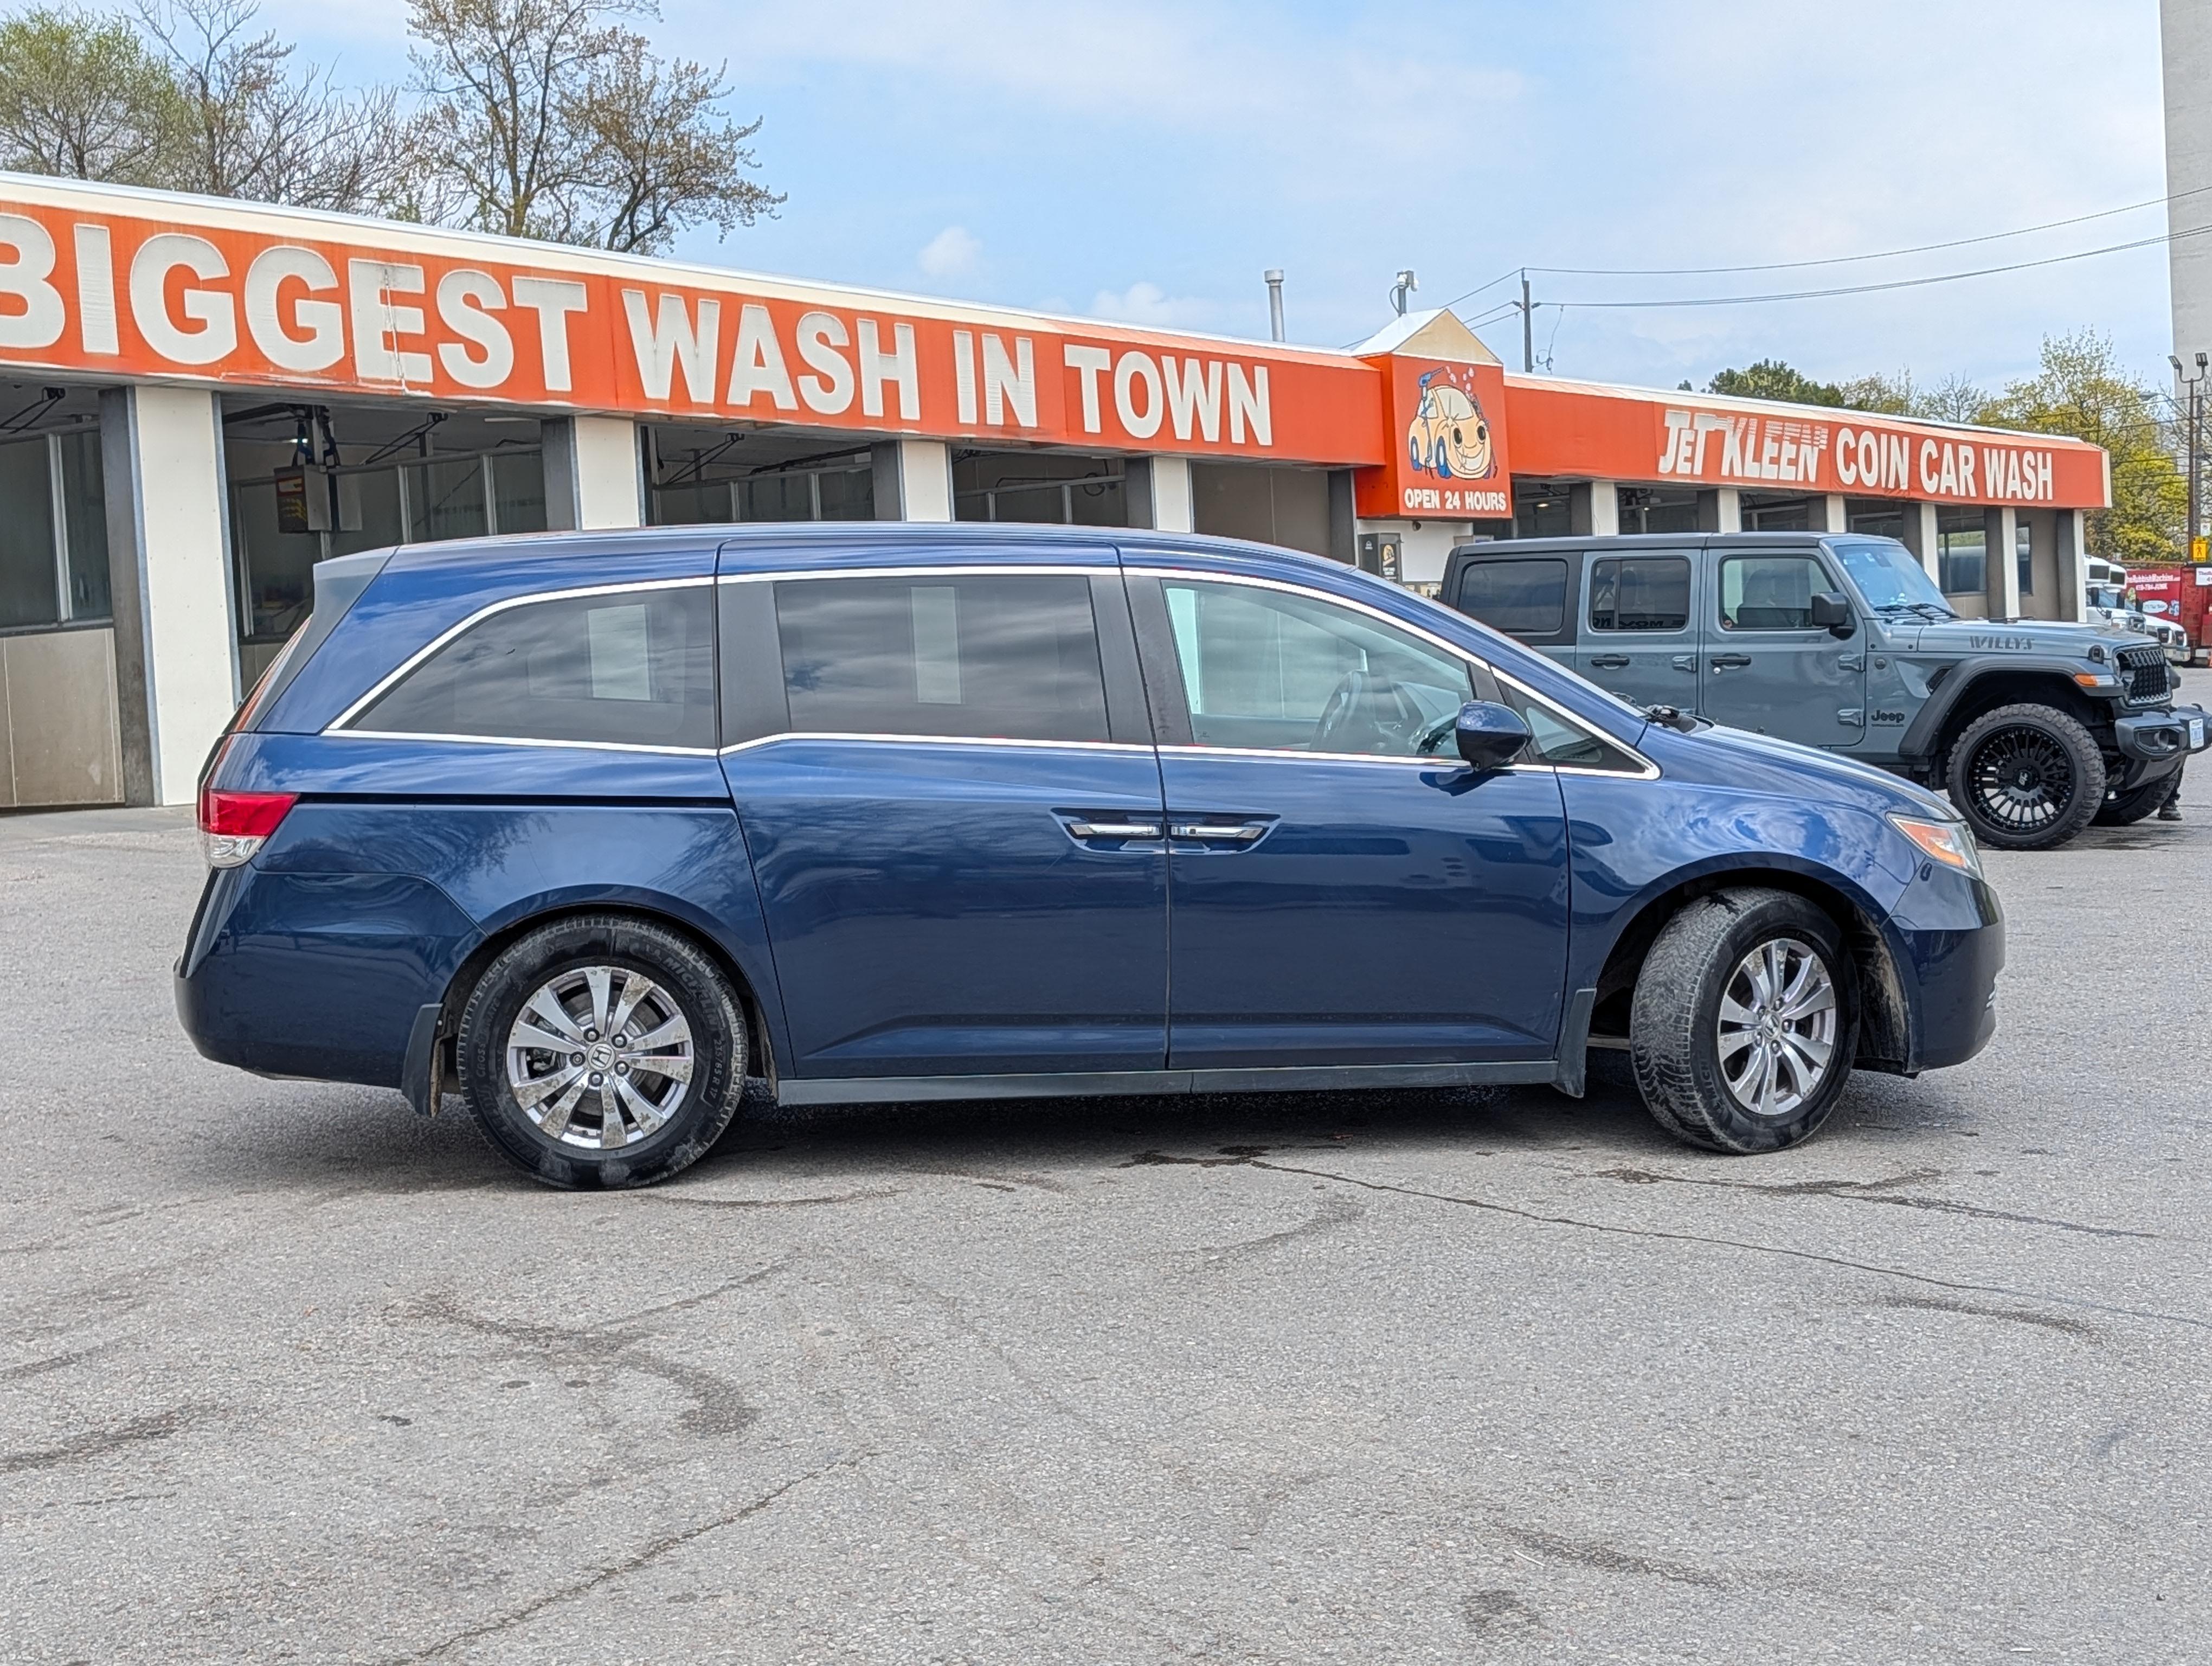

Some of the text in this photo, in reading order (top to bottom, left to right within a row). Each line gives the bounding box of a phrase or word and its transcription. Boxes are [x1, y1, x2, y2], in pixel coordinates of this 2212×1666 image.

[0, 213, 1272, 446] BIGGEST WASH IN TOWN
[1659, 409, 2053, 501] JET KLEEN COIN CAR WASH
[1404, 488, 1507, 511] OPEN 24 HOURS
[1970, 636, 2036, 650] WILLYS
[1871, 709, 1905, 723] Jeep
